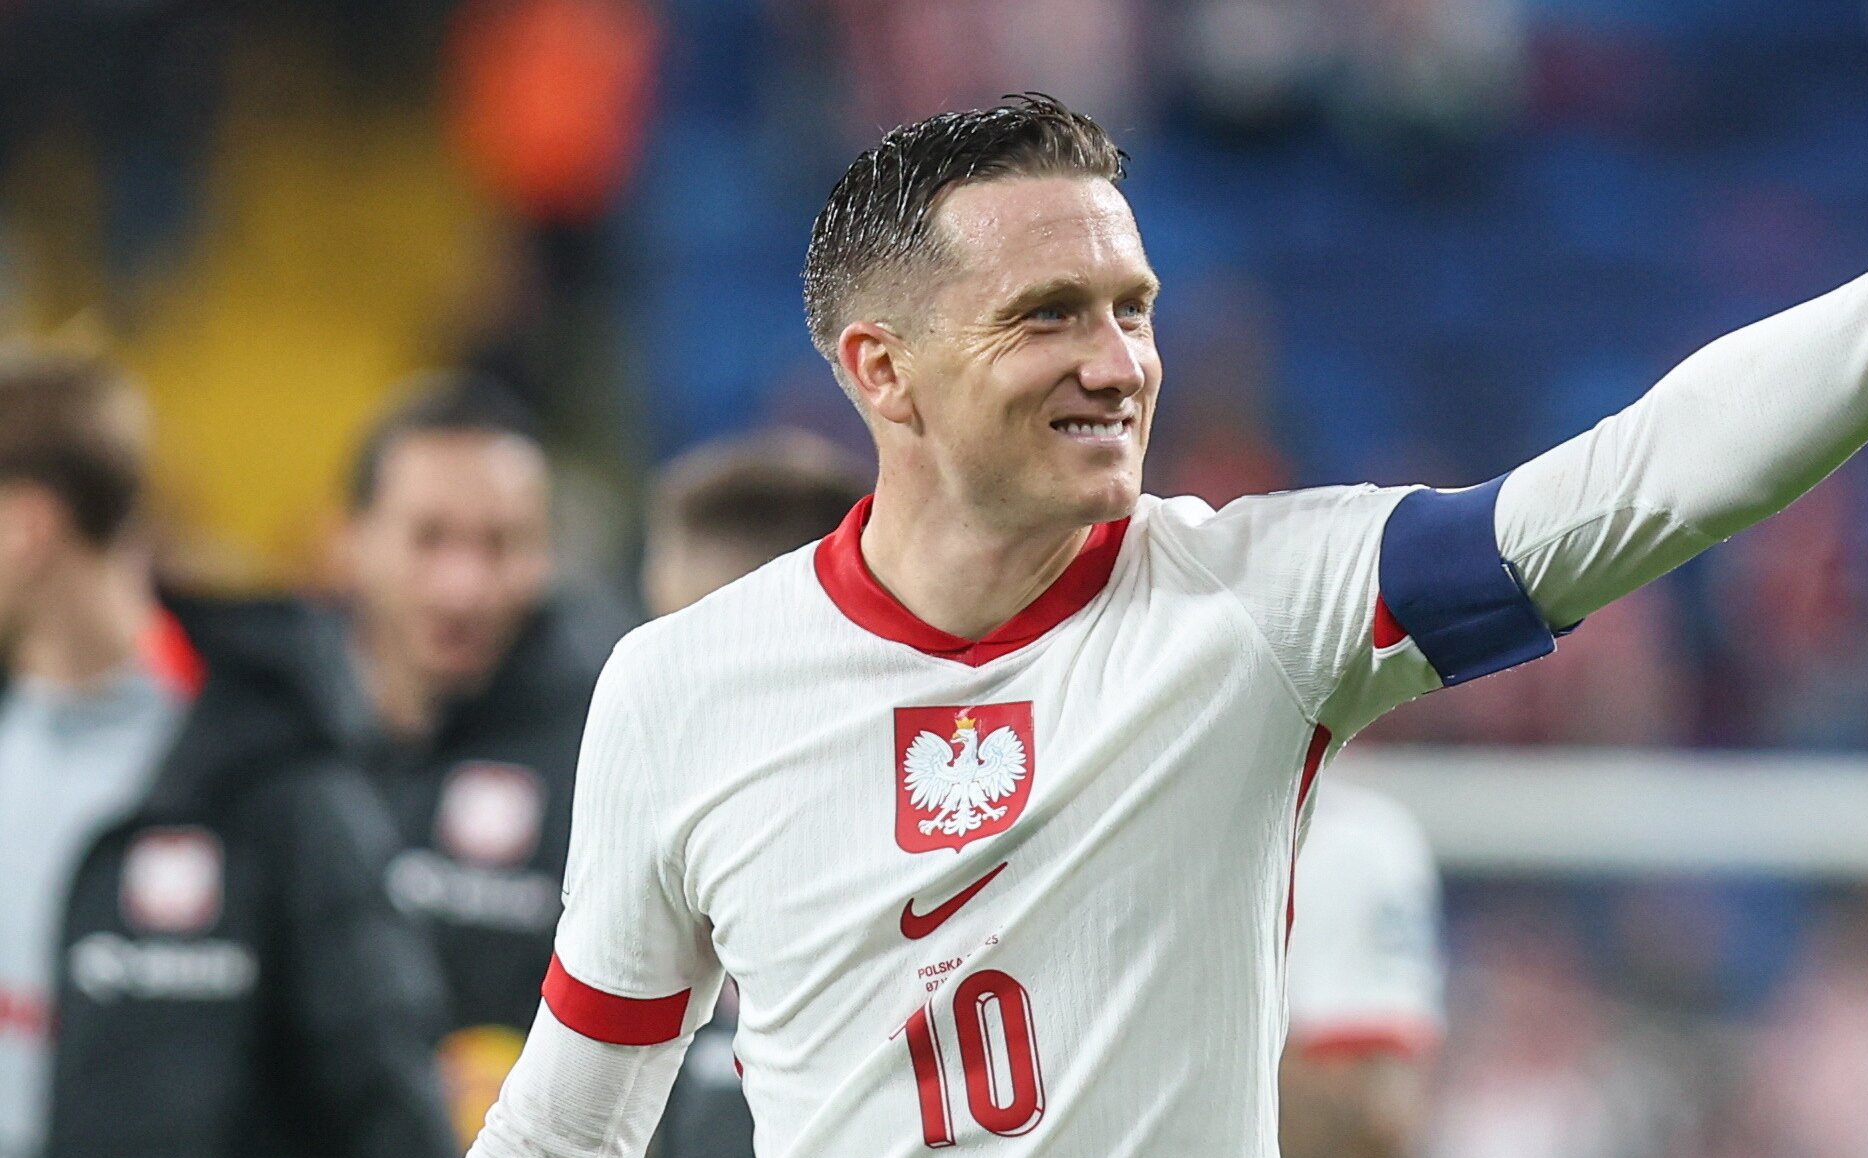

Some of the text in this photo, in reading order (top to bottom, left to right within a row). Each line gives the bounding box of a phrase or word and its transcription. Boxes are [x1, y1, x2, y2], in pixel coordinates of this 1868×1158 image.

[917, 957, 963, 979] POLSKA
[925, 979, 940, 992] 07
[888, 969, 1046, 1149] 10
